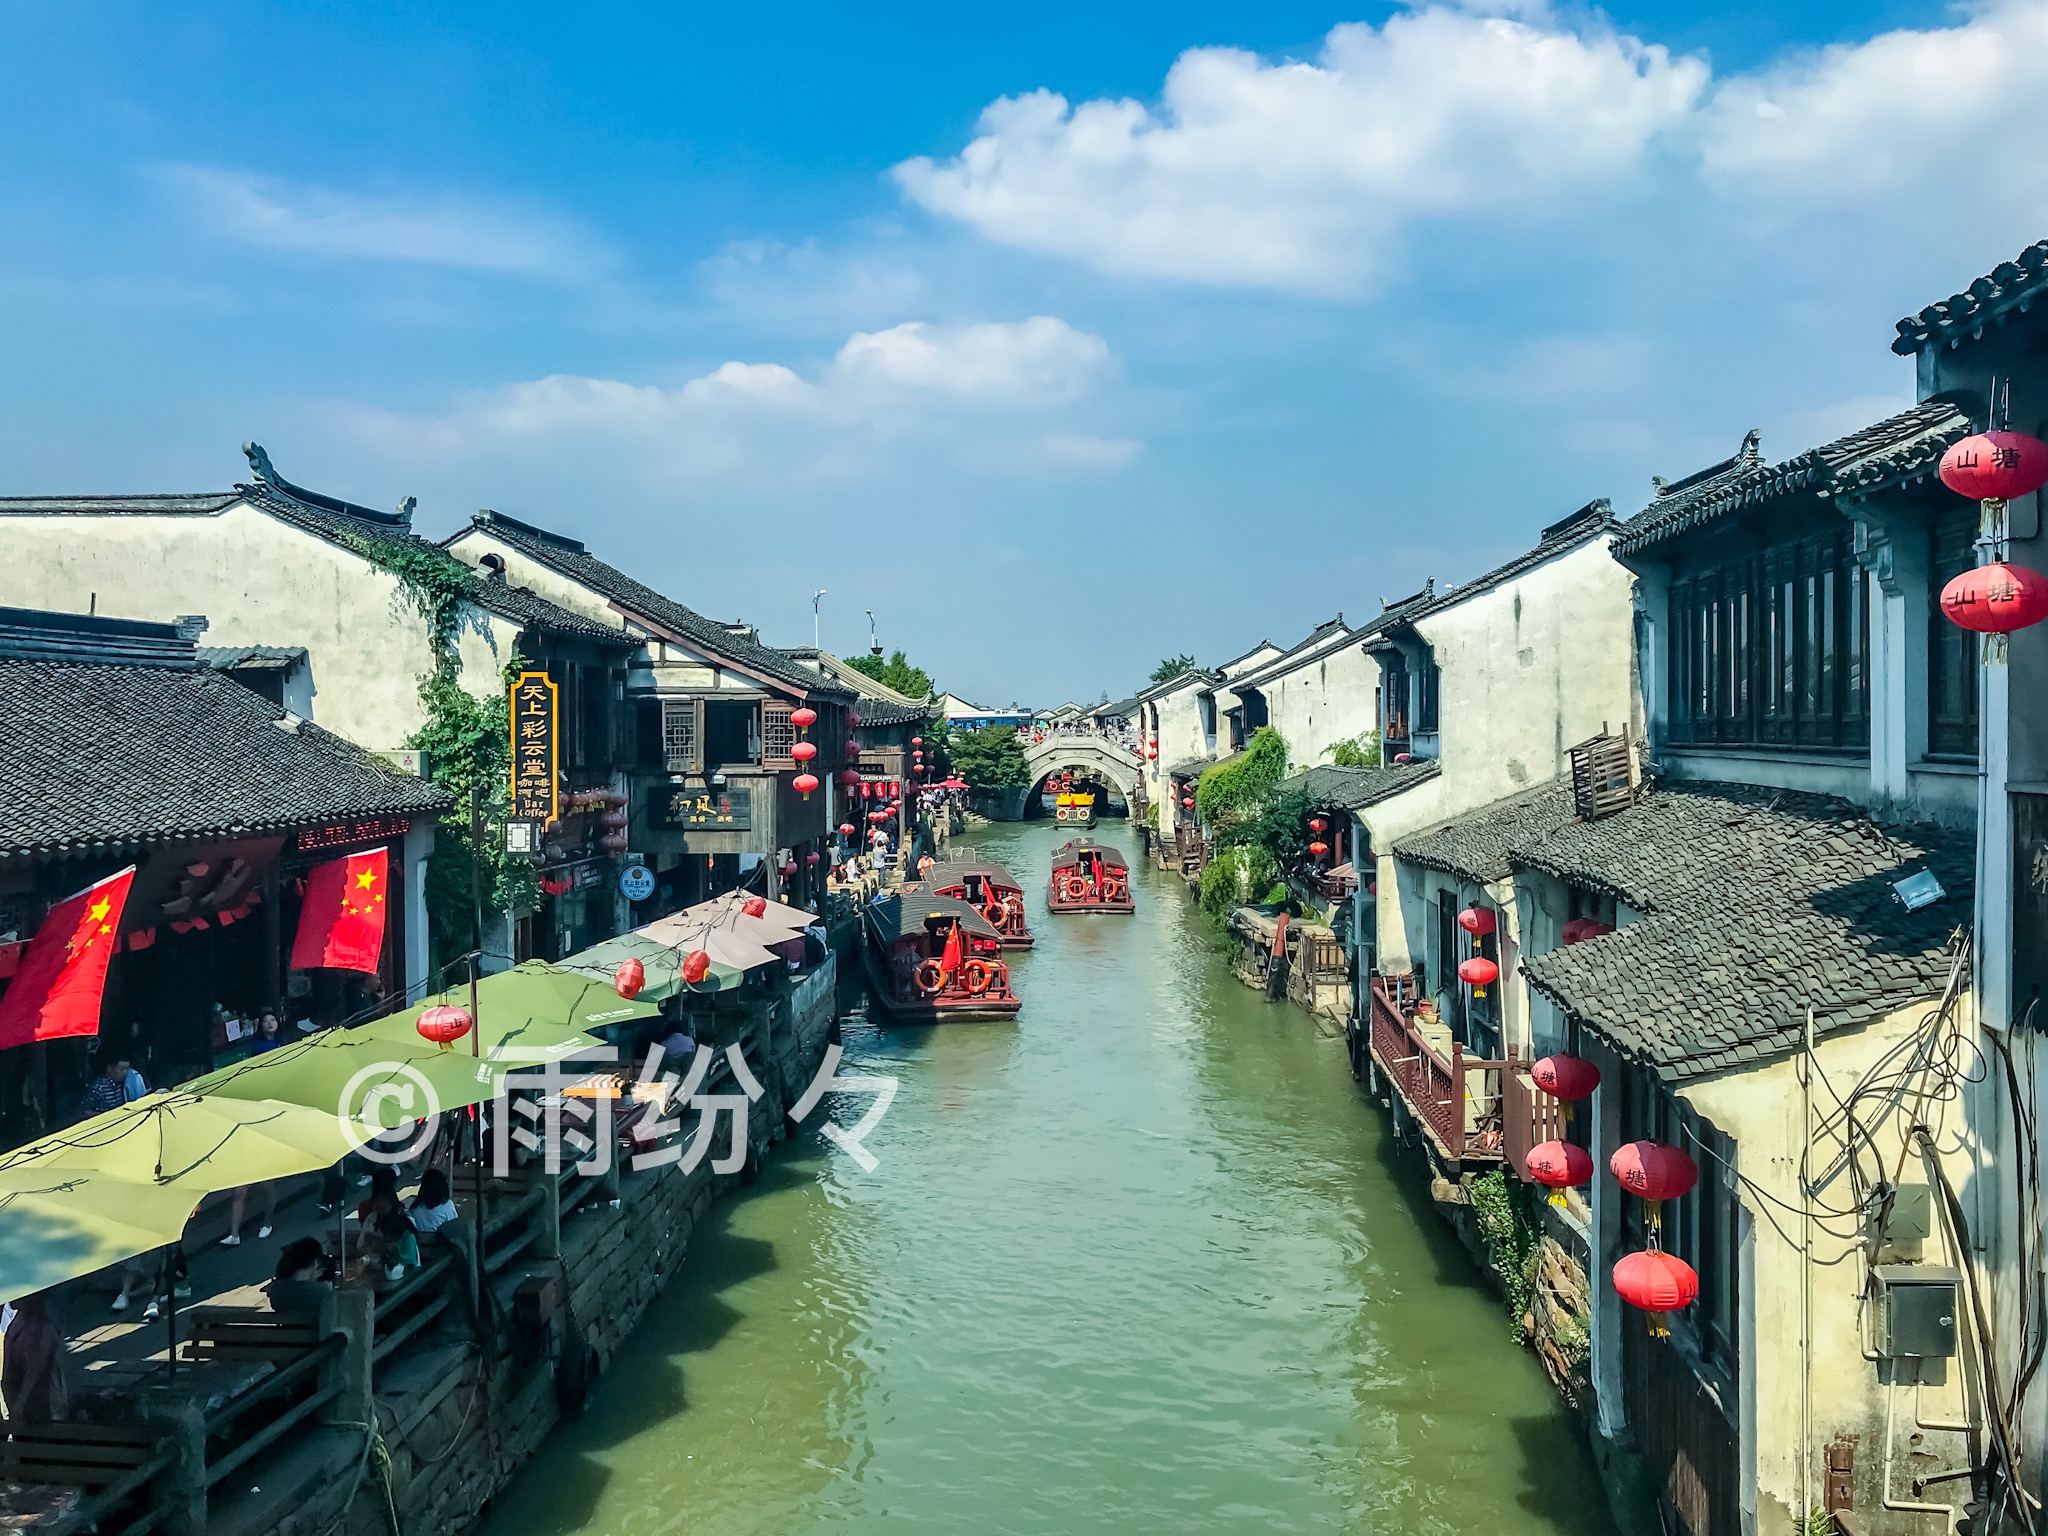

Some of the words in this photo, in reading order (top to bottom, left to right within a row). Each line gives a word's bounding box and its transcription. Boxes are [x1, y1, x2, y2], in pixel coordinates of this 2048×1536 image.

[1957, 447, 2021, 468] 山塘
[1955, 581, 2021, 605] 山塘
[520, 685, 547, 777] 天上彩云堂
[517, 778, 551, 788] 咖啡
[524, 799, 544, 808] Bar
[669, 794, 717, 814] 初见
